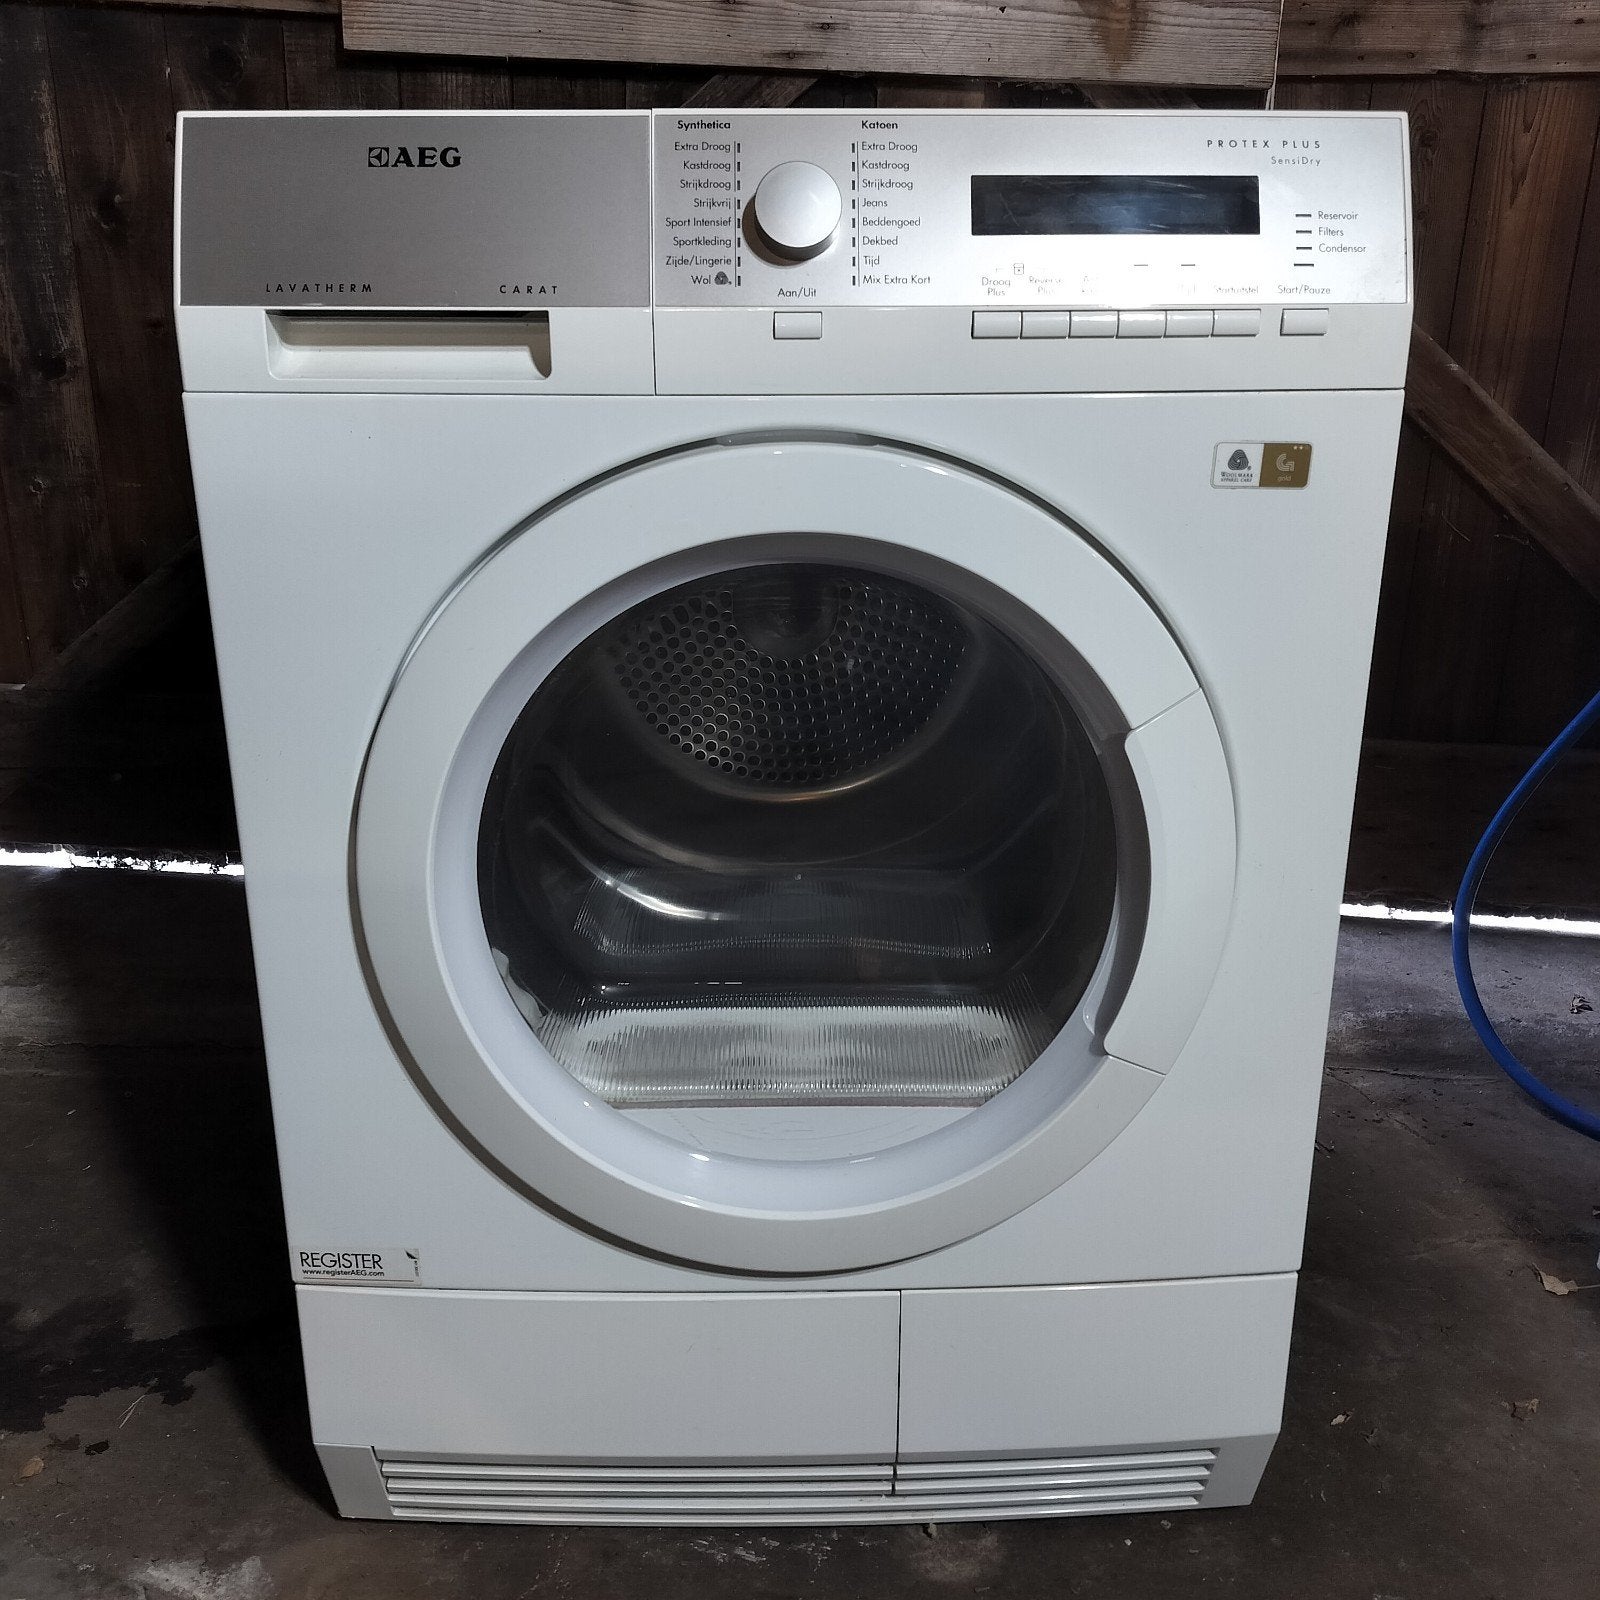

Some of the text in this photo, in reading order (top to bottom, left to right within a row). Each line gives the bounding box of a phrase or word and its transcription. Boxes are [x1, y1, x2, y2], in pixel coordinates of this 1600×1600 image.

[677, 119, 731, 131] Synthetica
[861, 120, 898, 130] Katoen
[674, 142, 731, 153] Extra Droog
[861, 142, 918, 153] Extra Droog
[1206, 139, 1322, 149] PROTEX PLUS
[392, 146, 462, 168] AEG
[1271, 156, 1322, 167] SensiDry
[683, 160, 731, 172] Kastdroog
[861, 160, 910, 172] Kastdroog
[680, 179, 731, 191] Strijkdroog
[861, 179, 914, 191] Strijkdroog
[693, 198, 732, 210] Strijkvrij
[861, 198, 888, 208] Jeans
[1318, 210, 1359, 221] Reservoir
[665, 217, 732, 228] Sport Intensief
[862, 217, 921, 228] Beddengoed
[1318, 227, 1344, 237] Filters
[673, 236, 732, 248] Sportkleding
[862, 236, 898, 246] Dekbed
[1318, 243, 1367, 253] Condensor
[665, 256, 732, 267] Zijde/Lingerie
[863, 255, 880, 267] Tijd
[691, 275, 711, 285] Wol
[863, 275, 931, 285] Mix Extra Kort
[266, 283, 373, 293] LAVATHERM
[499, 285, 558, 295] CARAT
[777, 287, 817, 298] Aan/Uit
[1277, 285, 1331, 296] Start/Pauze
[299, 1251, 383, 1269] REGISTER
[302, 1268, 385, 1278] www.registerAEG.com
